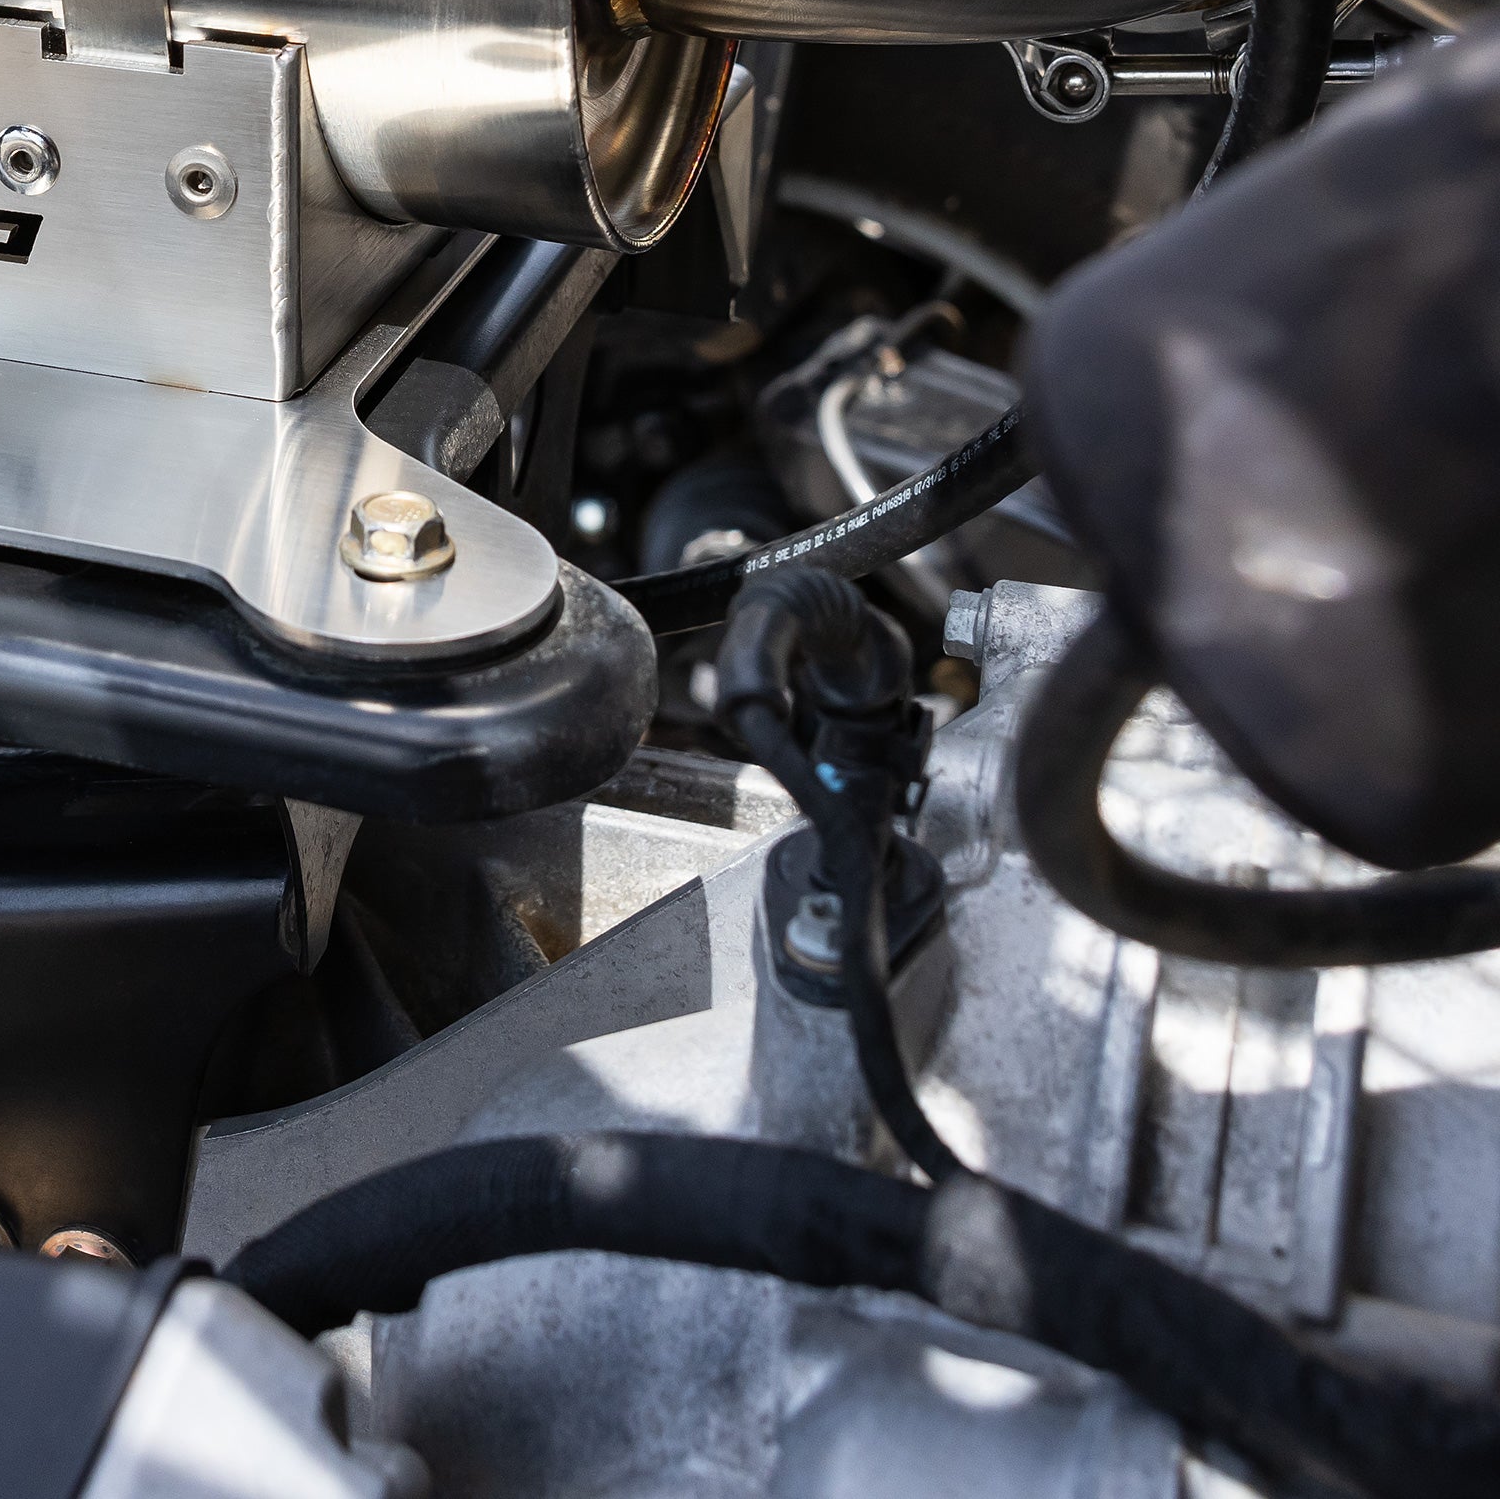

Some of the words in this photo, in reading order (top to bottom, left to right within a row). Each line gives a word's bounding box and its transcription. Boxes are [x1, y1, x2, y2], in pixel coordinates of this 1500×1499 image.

[775, 547, 791, 563] SAE
[793, 539, 811, 557] 20R3
[826, 522, 846, 542] 6.35
[847, 511, 870, 532] AKWEL
[914, 466, 947, 496] 07/31/23
